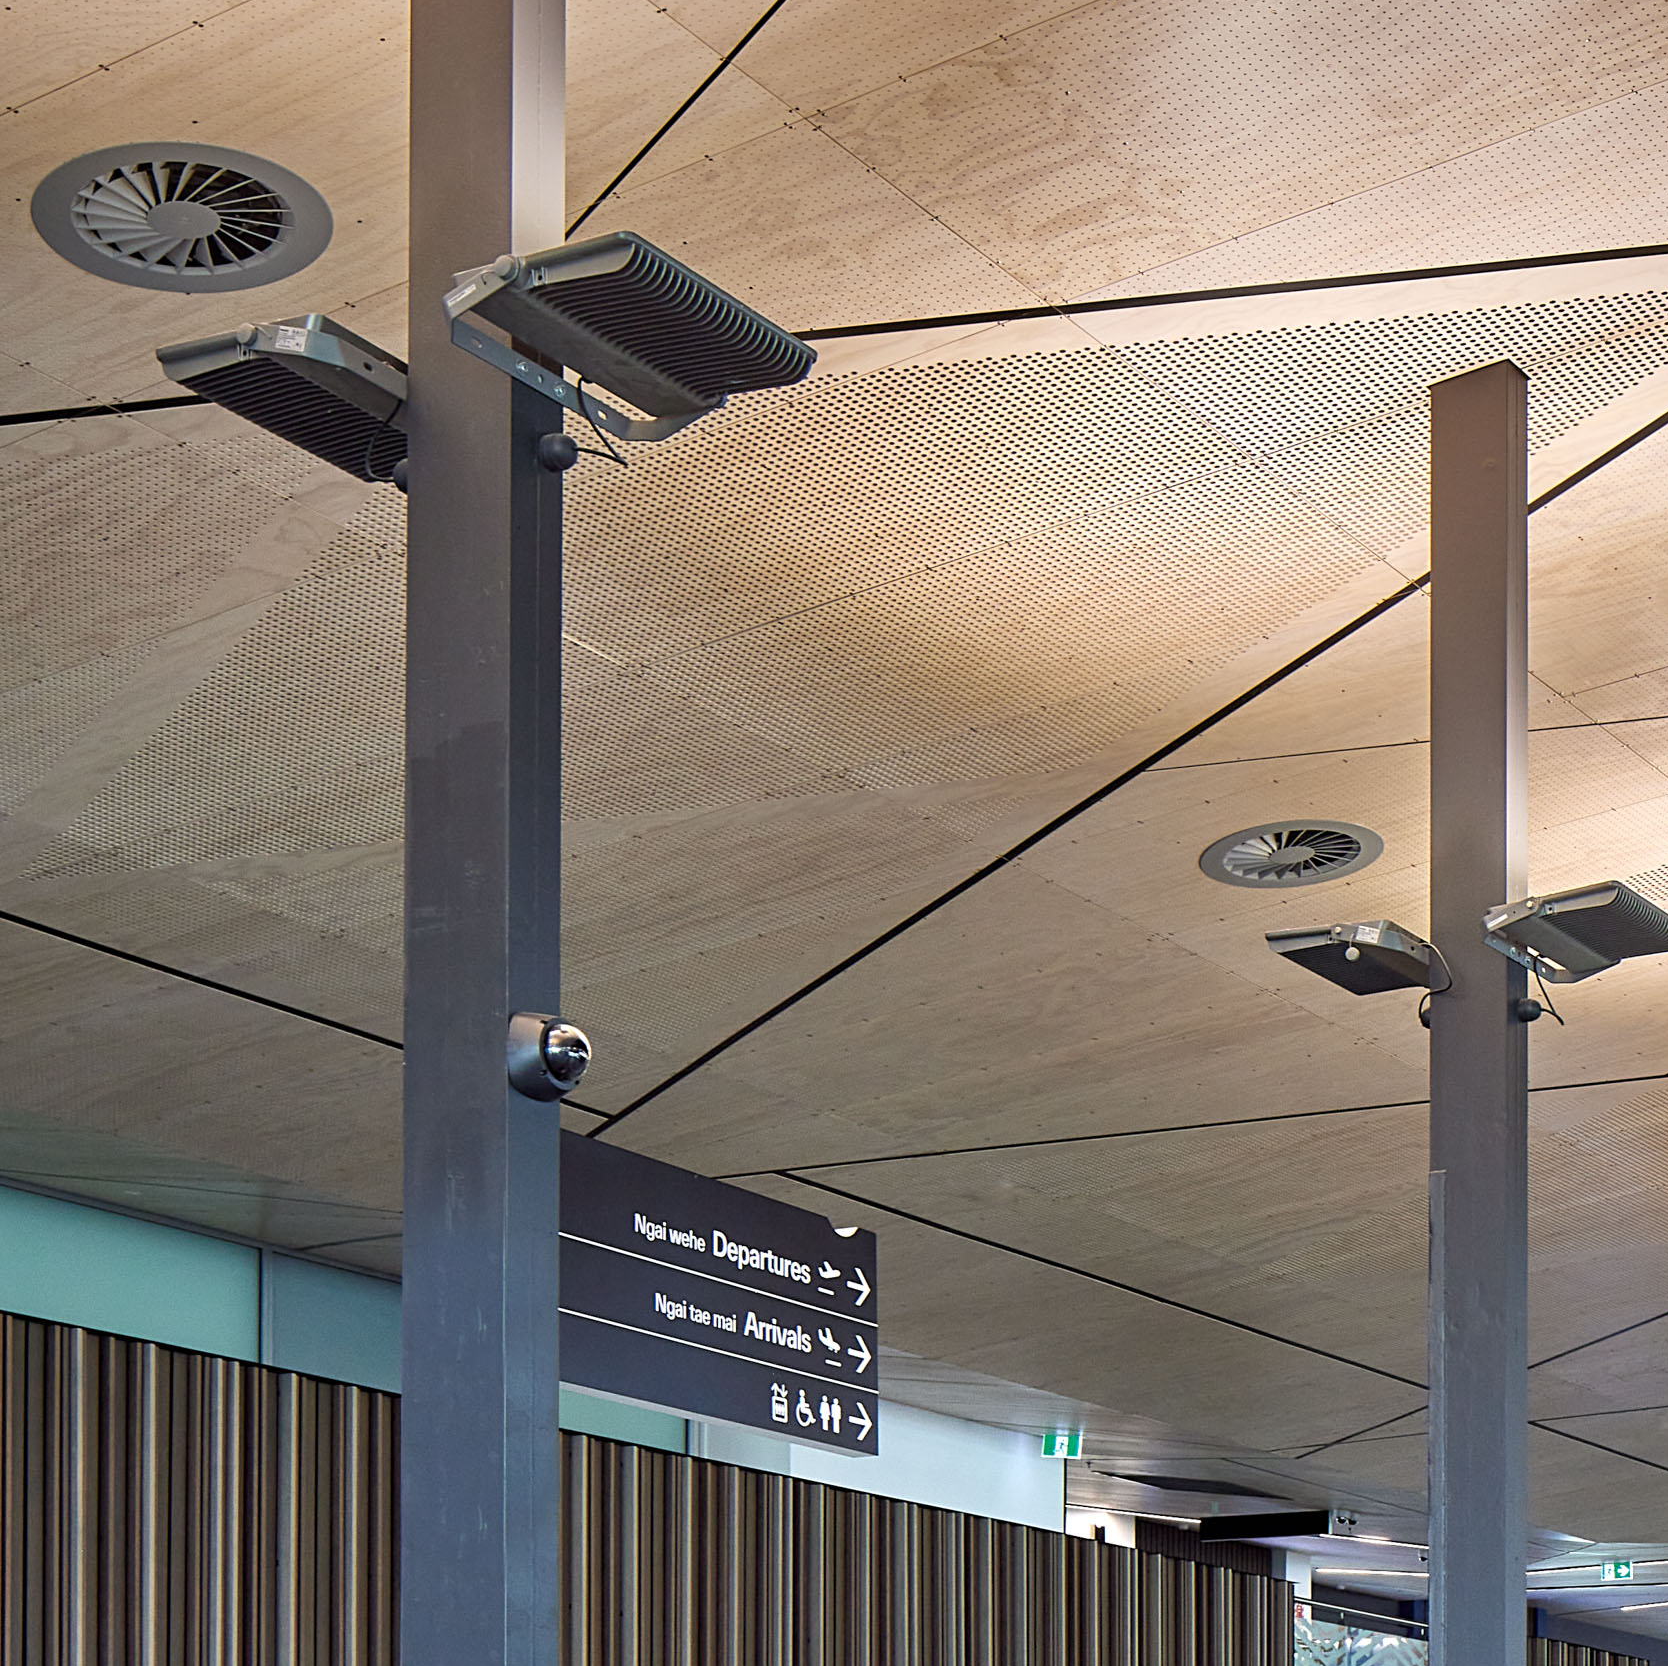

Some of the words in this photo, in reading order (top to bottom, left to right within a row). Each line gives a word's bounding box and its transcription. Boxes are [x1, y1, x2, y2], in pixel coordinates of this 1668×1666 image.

[633, 1212, 667, 1242] Ngai
[669, 1227, 706, 1253] wehe
[712, 1229, 811, 1285] Departures
[654, 1292, 687, 1320] Ngai
[689, 1303, 711, 1327] tae
[712, 1313, 737, 1334] mai
[743, 1311, 812, 1354] Arrivals
